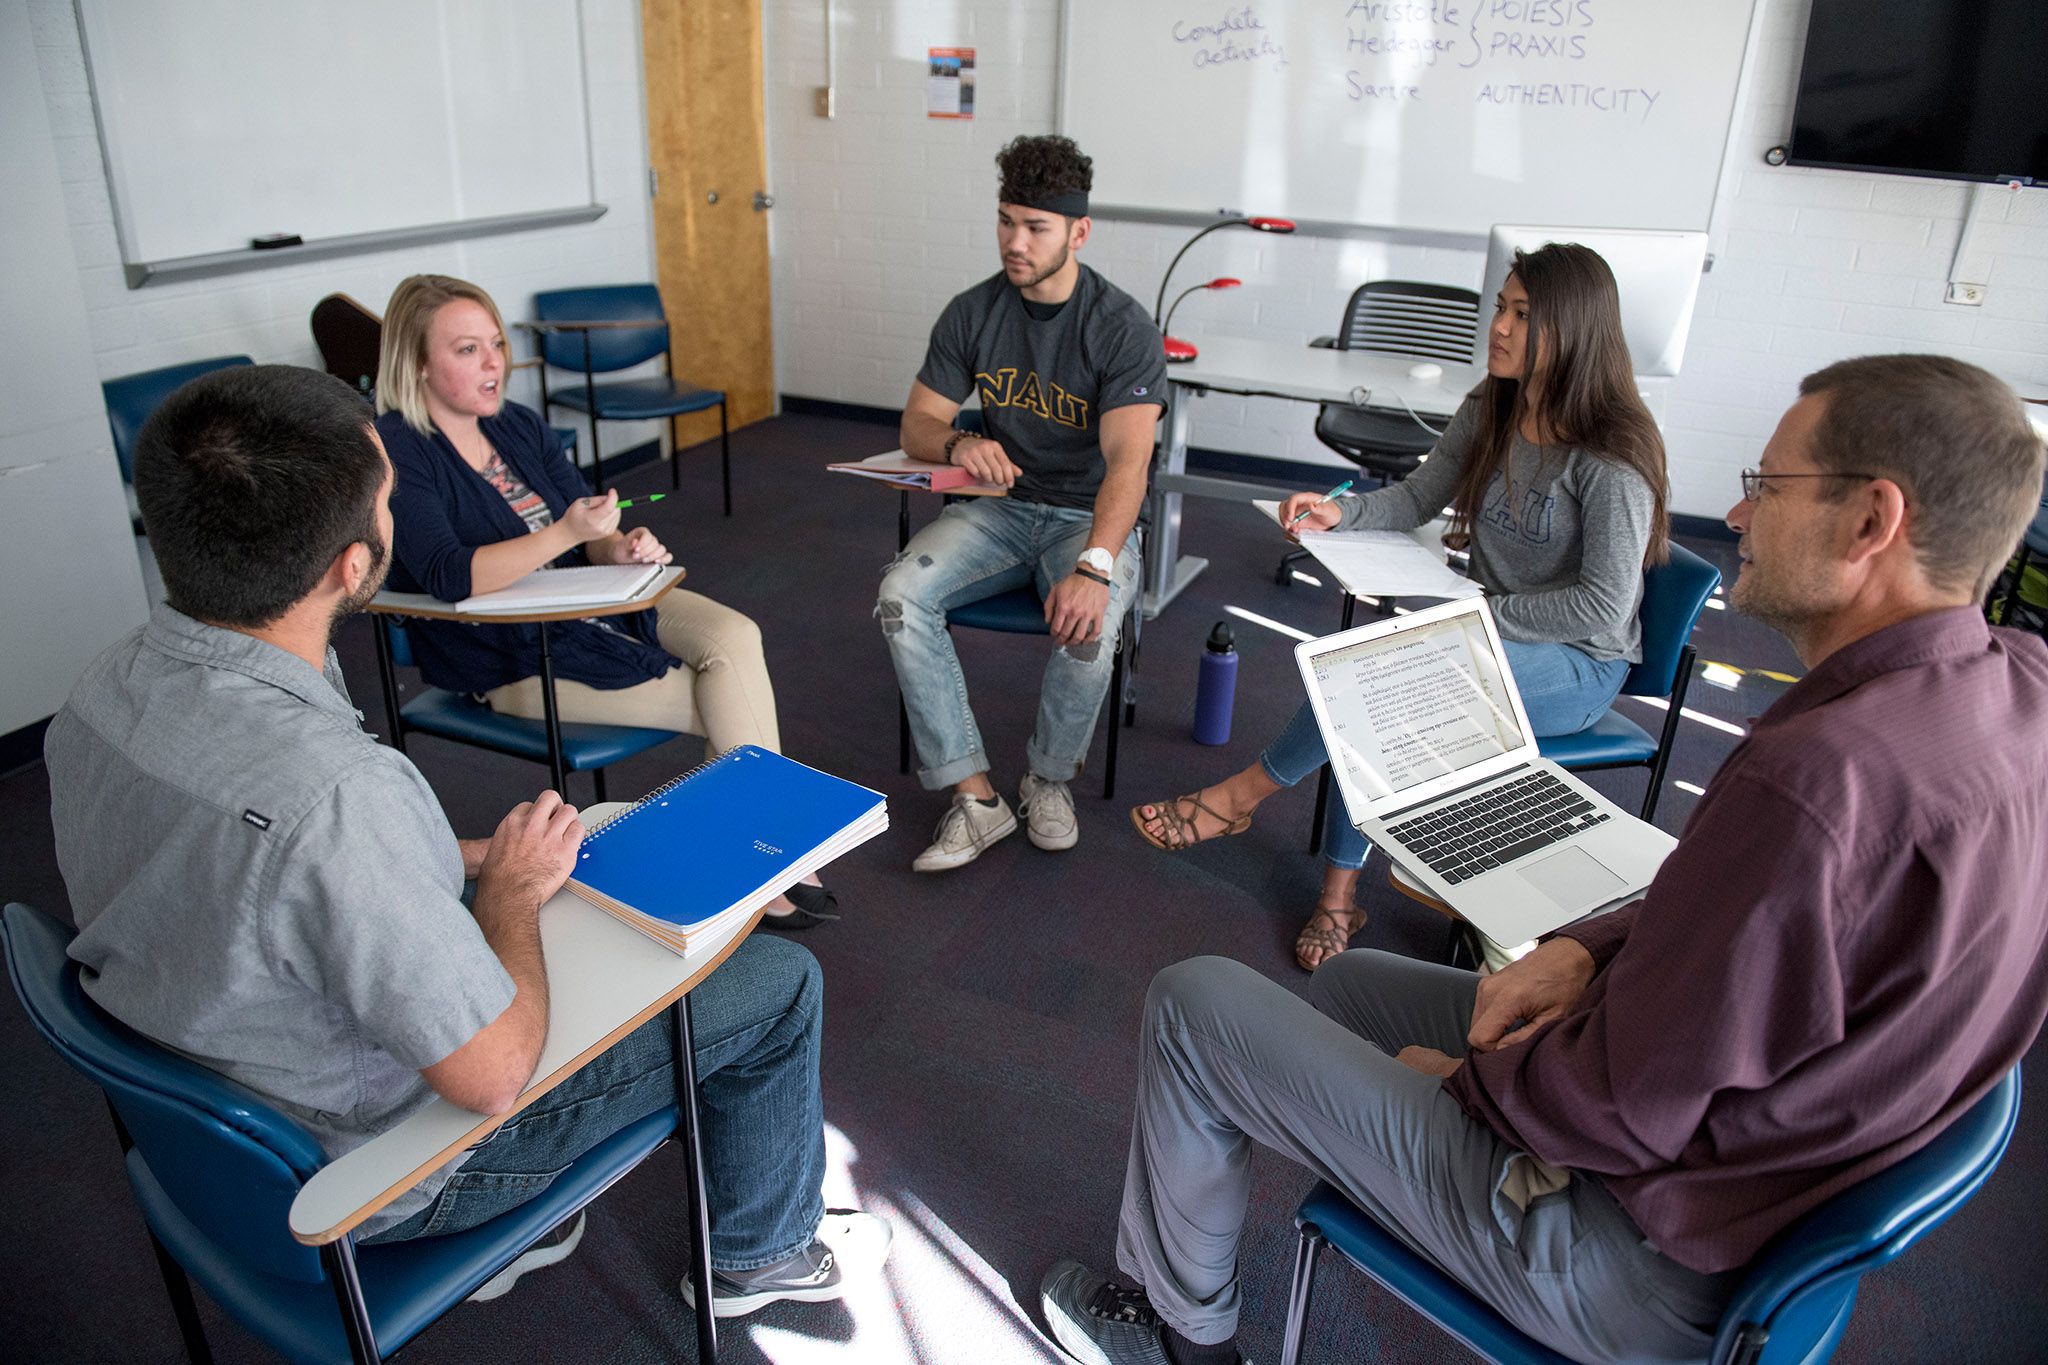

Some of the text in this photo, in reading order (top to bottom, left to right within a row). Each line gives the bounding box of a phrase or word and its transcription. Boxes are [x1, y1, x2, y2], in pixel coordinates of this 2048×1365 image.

[1171, 6, 1265, 44] Complete
[1345, 0, 1459, 26] Aristotle
[1490, 0, 1594, 27] POIESIS
[1489, 32, 1587, 60] PRAXIS
[1475, 84, 1660, 124] AUTHENTICITY
[975, 367, 1088, 430] NAU
